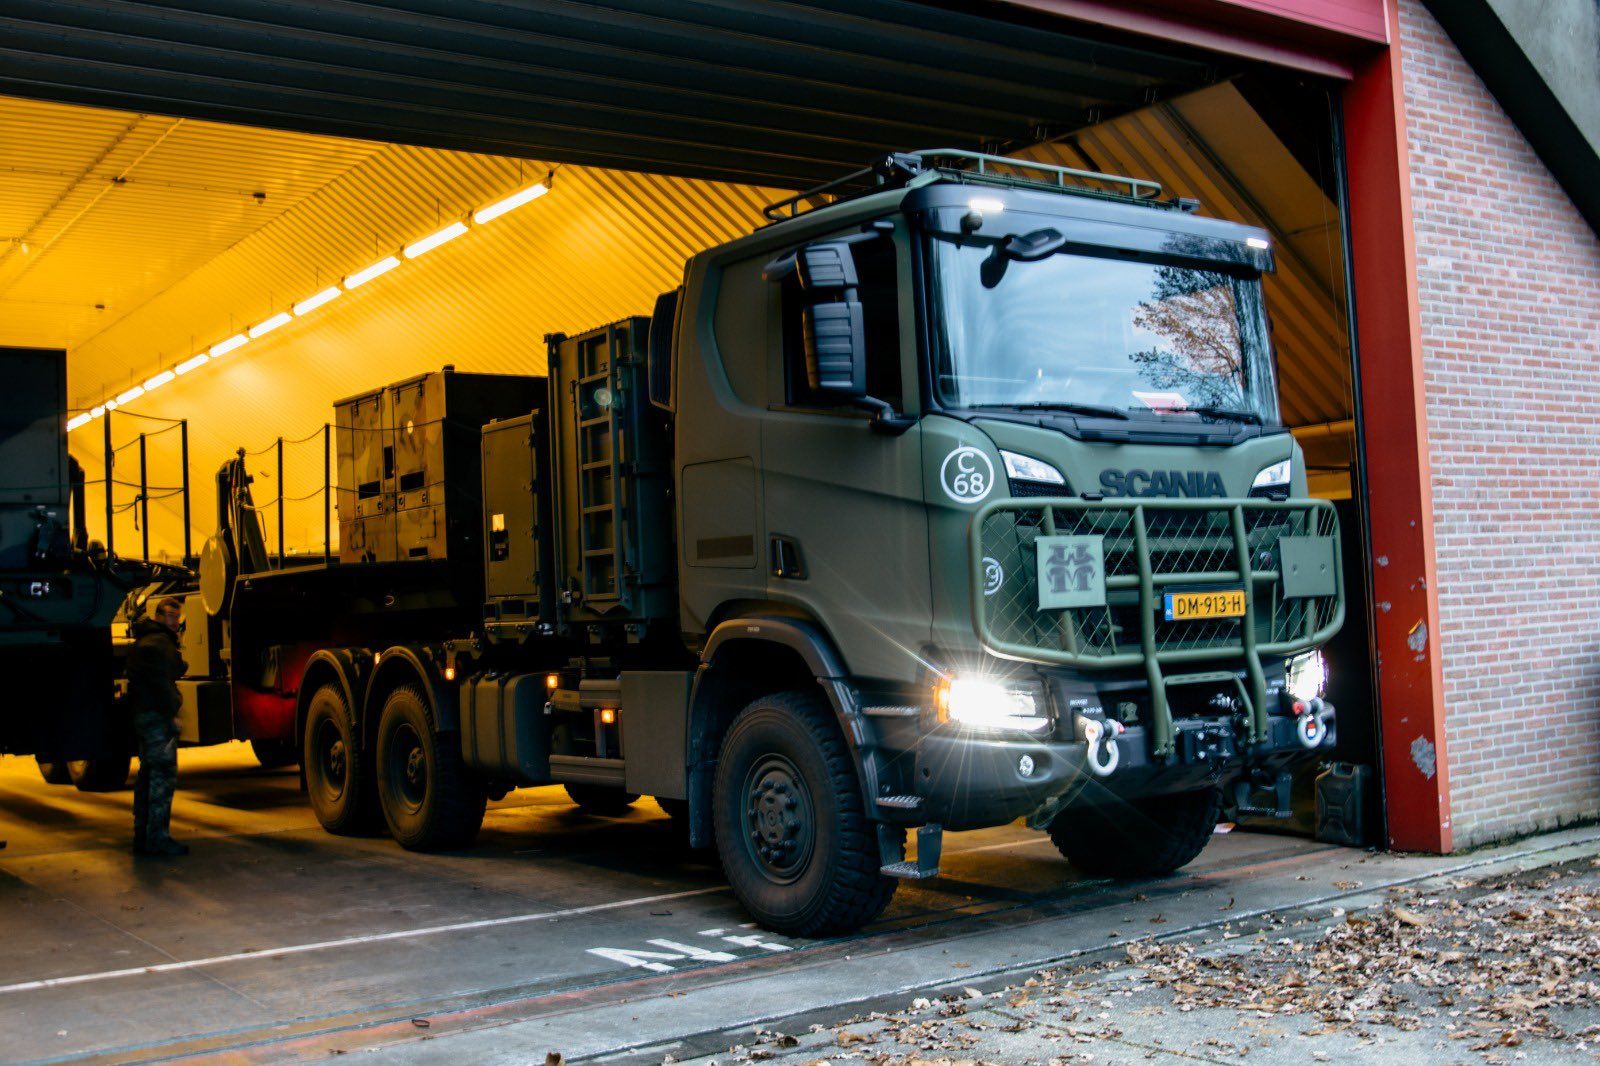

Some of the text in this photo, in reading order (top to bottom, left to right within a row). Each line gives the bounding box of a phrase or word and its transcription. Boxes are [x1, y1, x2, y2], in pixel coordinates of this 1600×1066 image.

[957, 451, 976, 474] C
[953, 472, 985, 496] 68
[1098, 468, 1228, 498] SCANIA
[1177, 594, 1242, 616] DM-913-H
